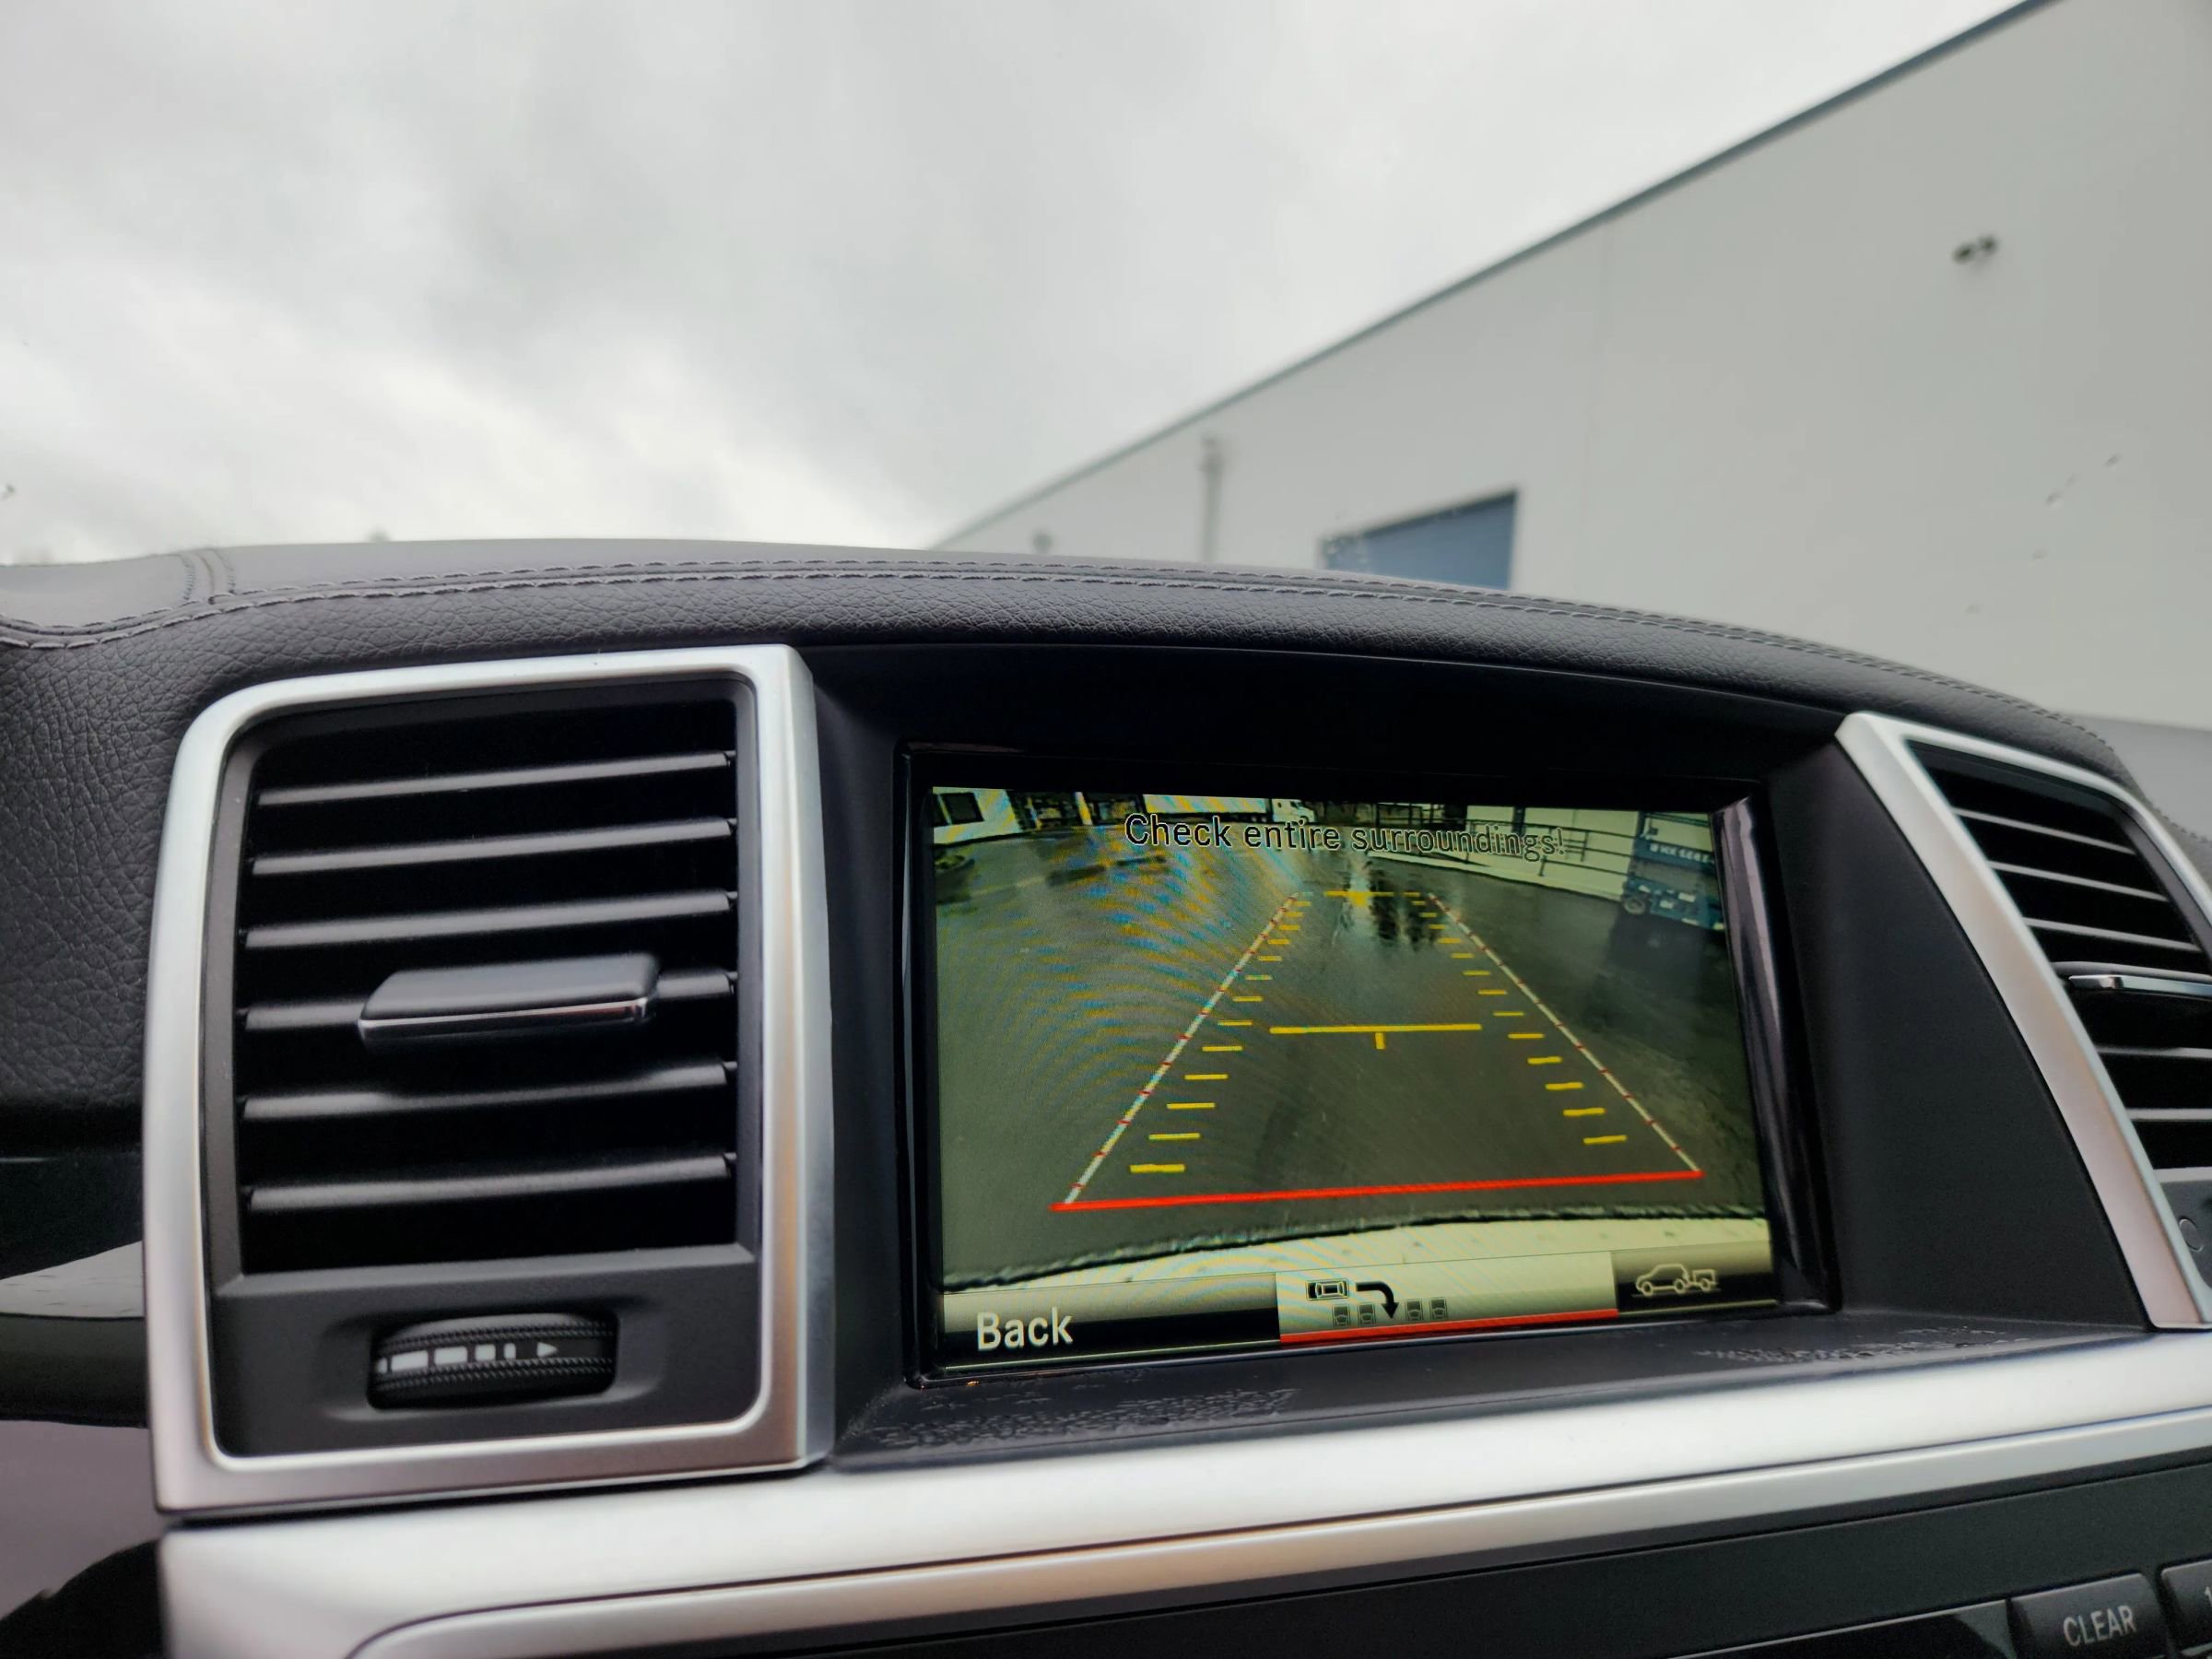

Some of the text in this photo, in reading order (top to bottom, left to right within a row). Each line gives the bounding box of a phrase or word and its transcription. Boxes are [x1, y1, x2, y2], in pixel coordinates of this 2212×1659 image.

[1124, 813, 1565, 862] Check entire surroundings!
[976, 1306, 1074, 1352] Back
[2063, 1605, 2137, 1647] CLEAR
